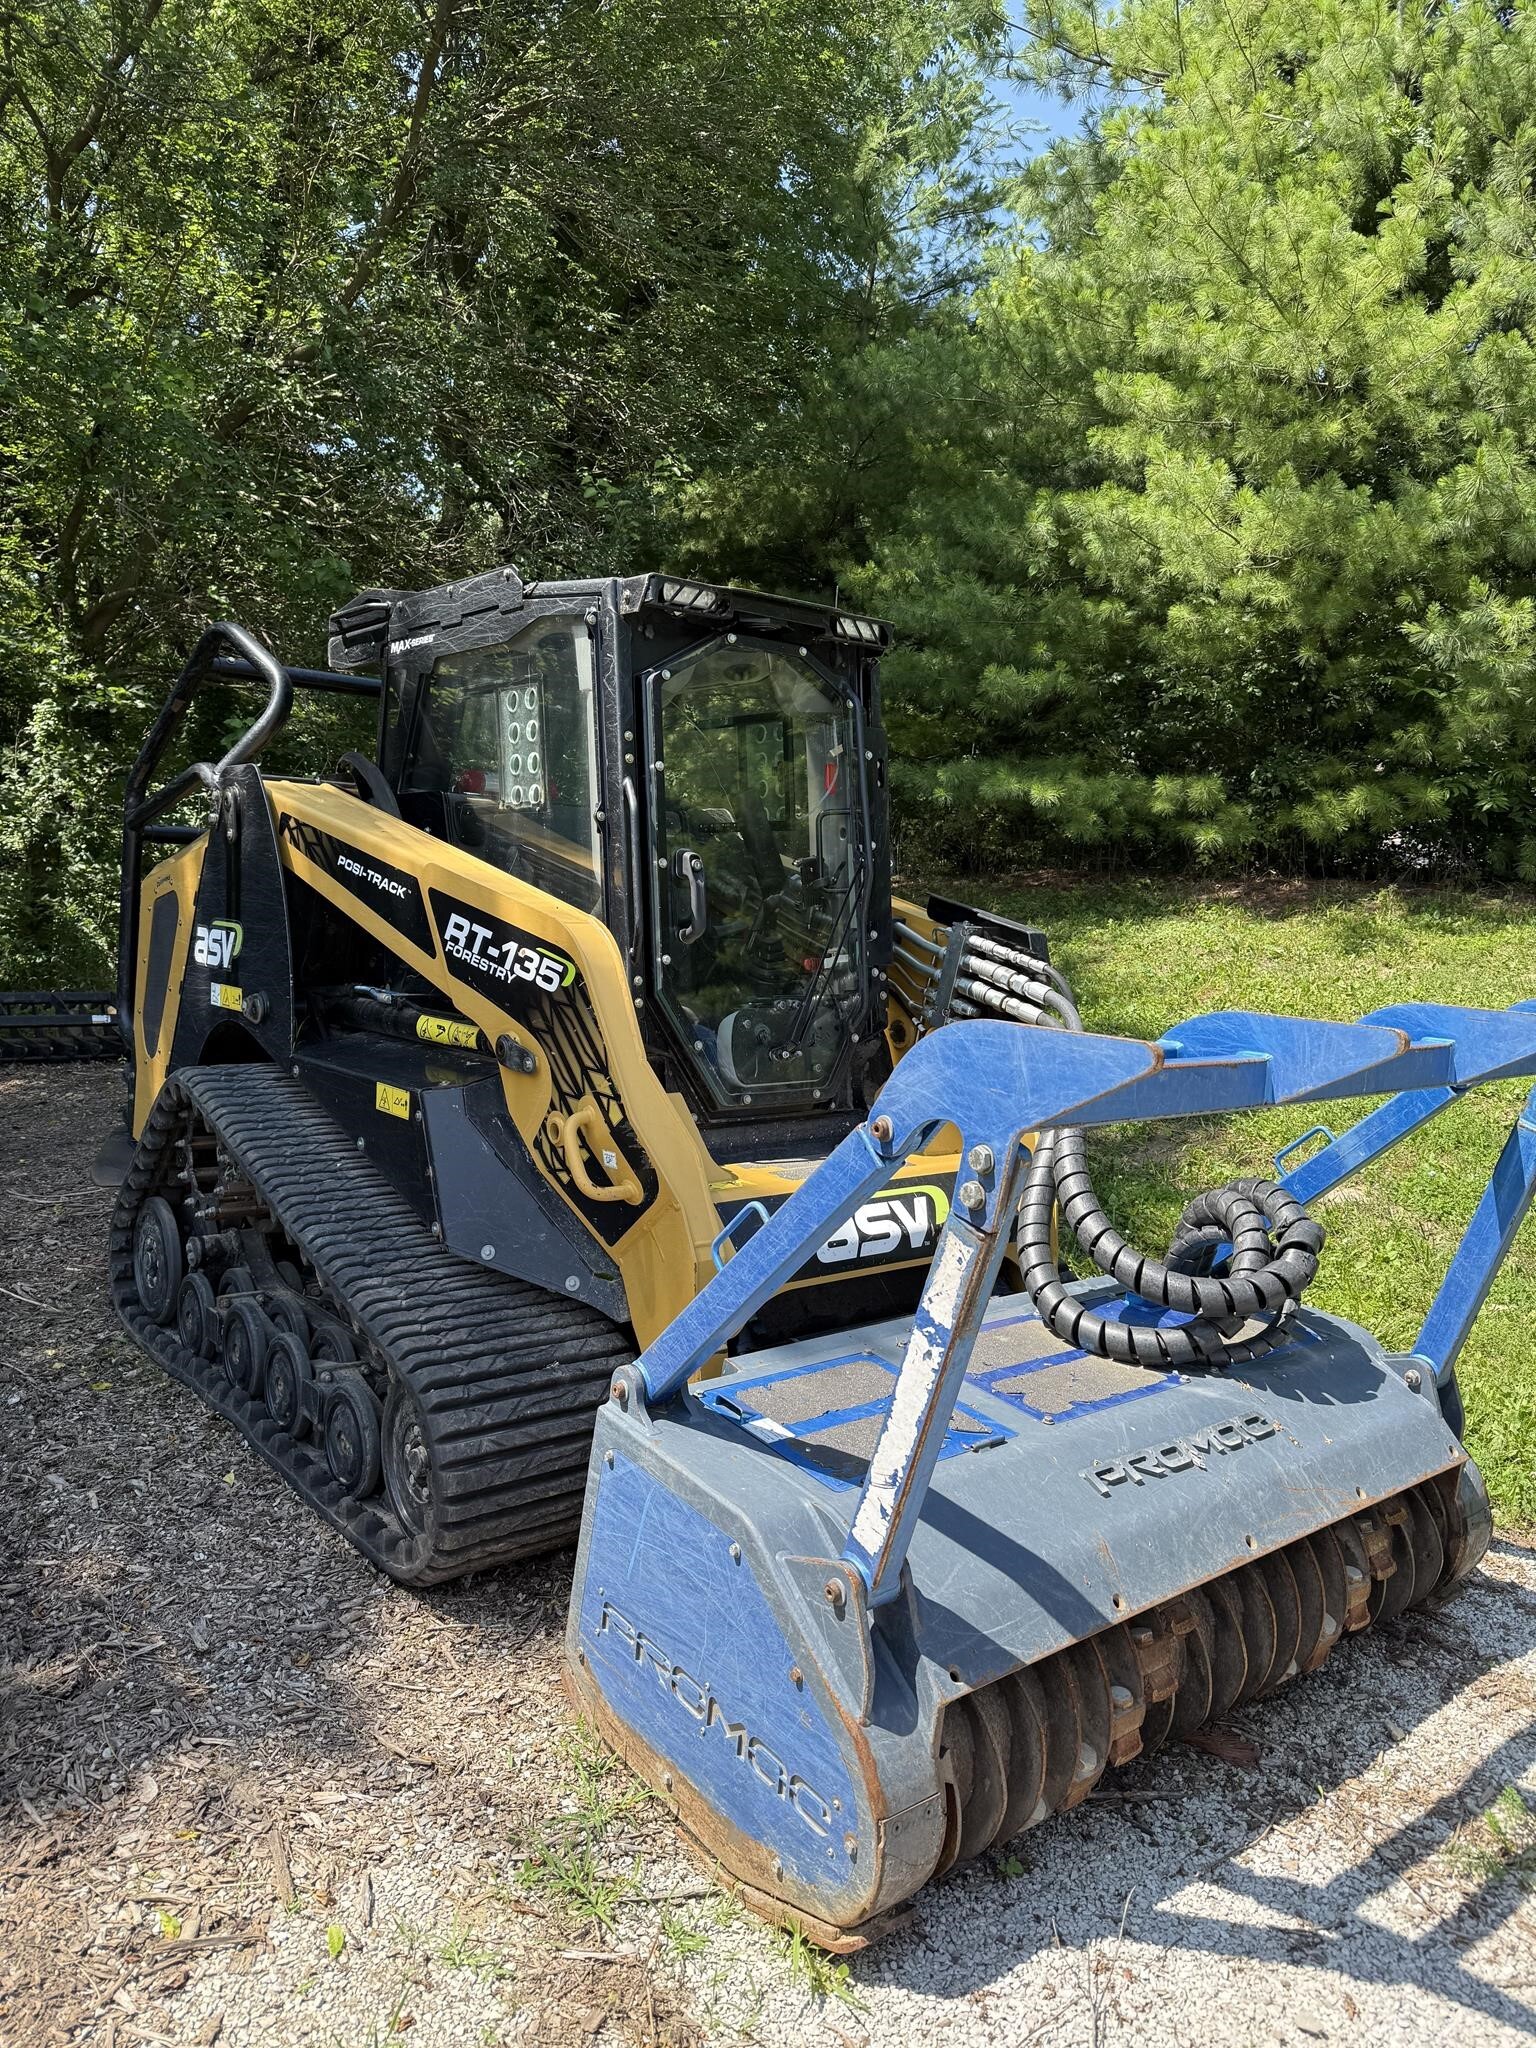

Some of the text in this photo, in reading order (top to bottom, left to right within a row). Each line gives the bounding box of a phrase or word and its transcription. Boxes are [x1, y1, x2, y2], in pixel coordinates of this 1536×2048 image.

[337, 855, 406, 899] POSI-TRACK
[444, 913, 564, 992] RT-135
[445, 940, 518, 984] FORESTRY
